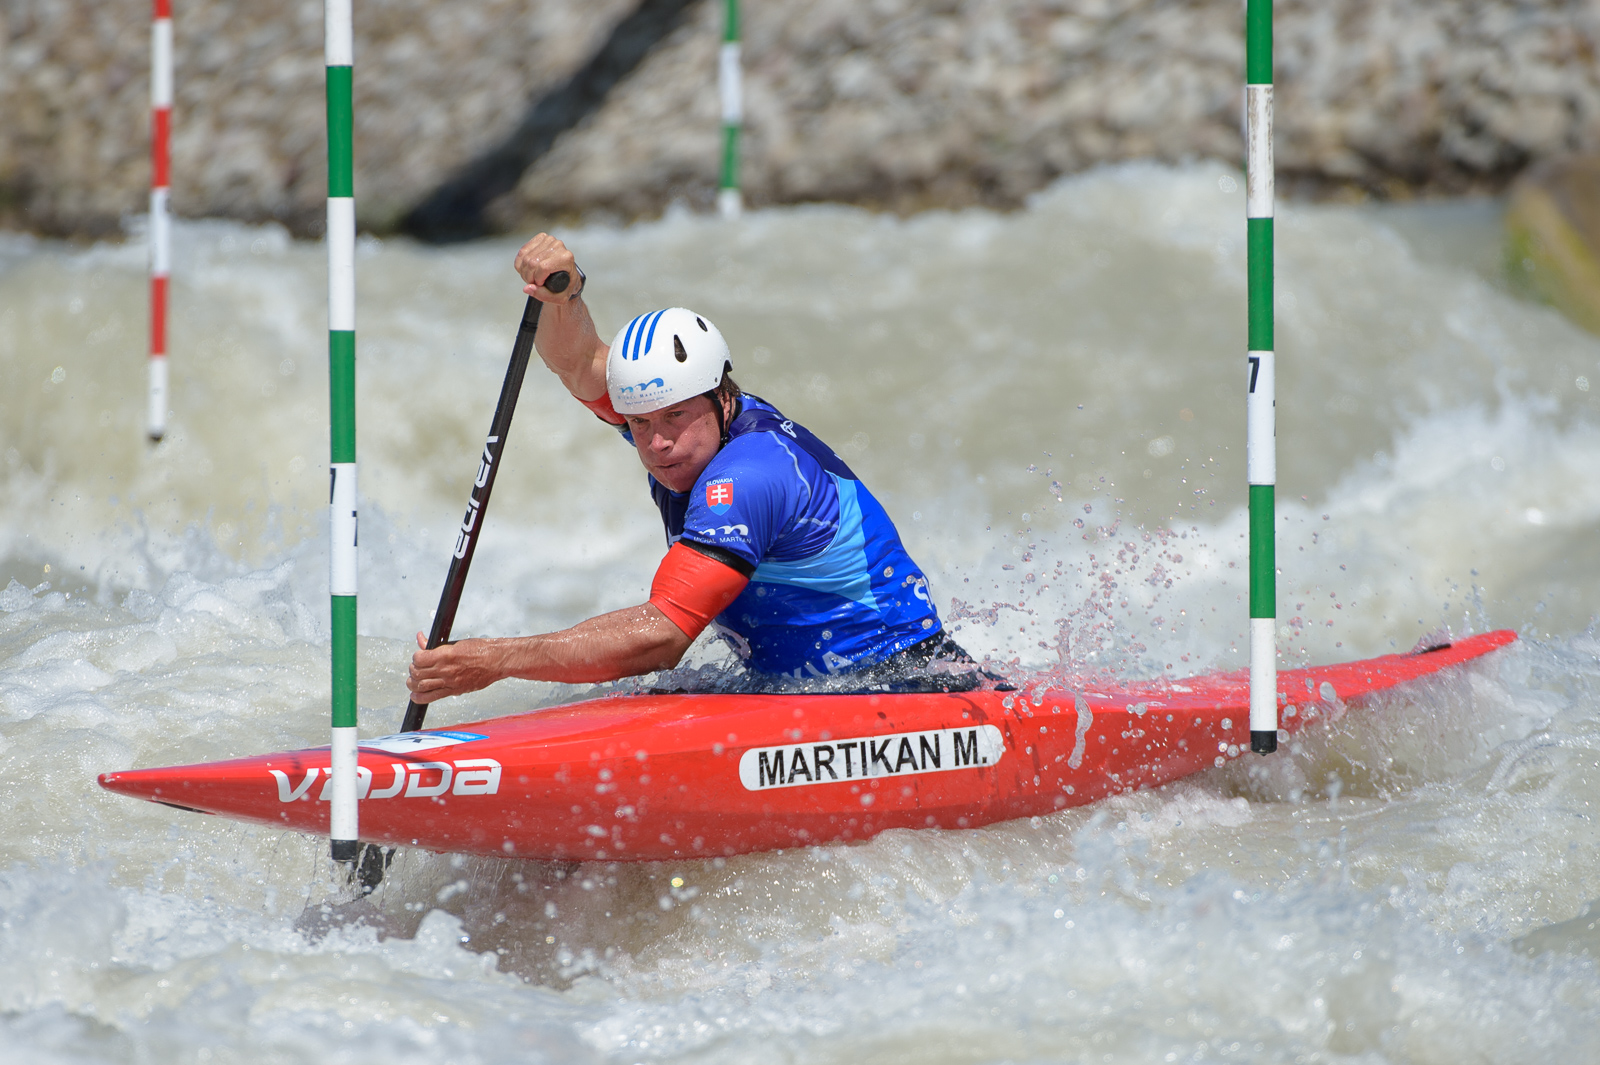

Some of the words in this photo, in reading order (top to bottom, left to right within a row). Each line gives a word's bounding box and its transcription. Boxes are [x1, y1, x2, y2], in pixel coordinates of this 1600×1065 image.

[1248, 357, 1260, 393] 7
[706, 477, 733, 487] SLOVAKIA
[693, 536, 717, 544] MICHAL
[719, 536, 752, 544] MARTIKAN
[757, 733, 942, 788] MARTIKAN
[953, 729, 988, 767] M.
